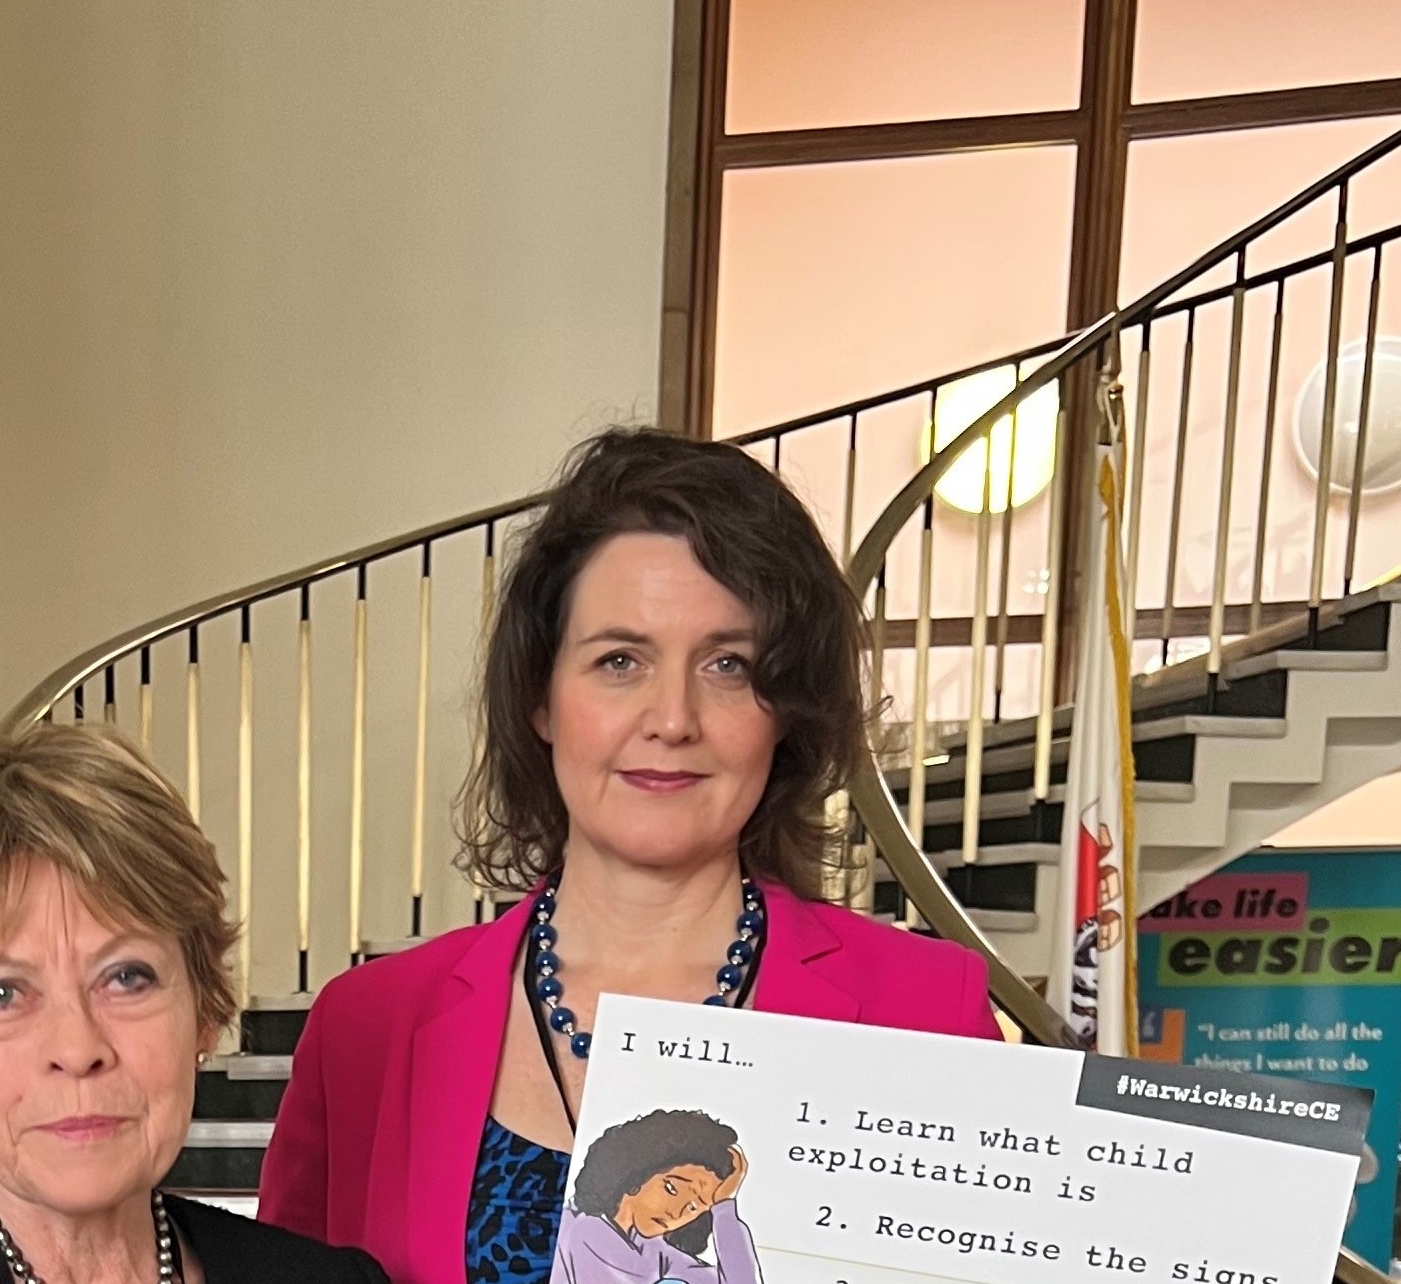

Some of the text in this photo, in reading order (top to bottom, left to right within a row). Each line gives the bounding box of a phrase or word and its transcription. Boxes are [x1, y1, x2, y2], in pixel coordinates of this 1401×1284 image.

[1138, 888, 1299, 919] ake life
[1168, 917, 1401, 976] easier
[620, 1031, 637, 1053] I
[1218, 1027, 1253, 1042] can
[1256, 1021, 1291, 1042] still
[1294, 1022, 1320, 1042] do
[1324, 1021, 1348, 1042] all
[1351, 1021, 1384, 1042] the
[1255, 1052, 1263, 1071] I
[1266, 1057, 1314, 1072] want
[1318, 1057, 1339, 1072] to
[1342, 1052, 1370, 1072] do
[1116, 1074, 1342, 1122] #WarwickshireCE
[796, 1101, 1194, 1175] 1. Learn what child
[788, 1143, 1096, 1203] exploitation is
[814, 1205, 848, 1230] 2.
[874, 1215, 1061, 1261] Recognise
[1085, 1245, 1147, 1274] the
